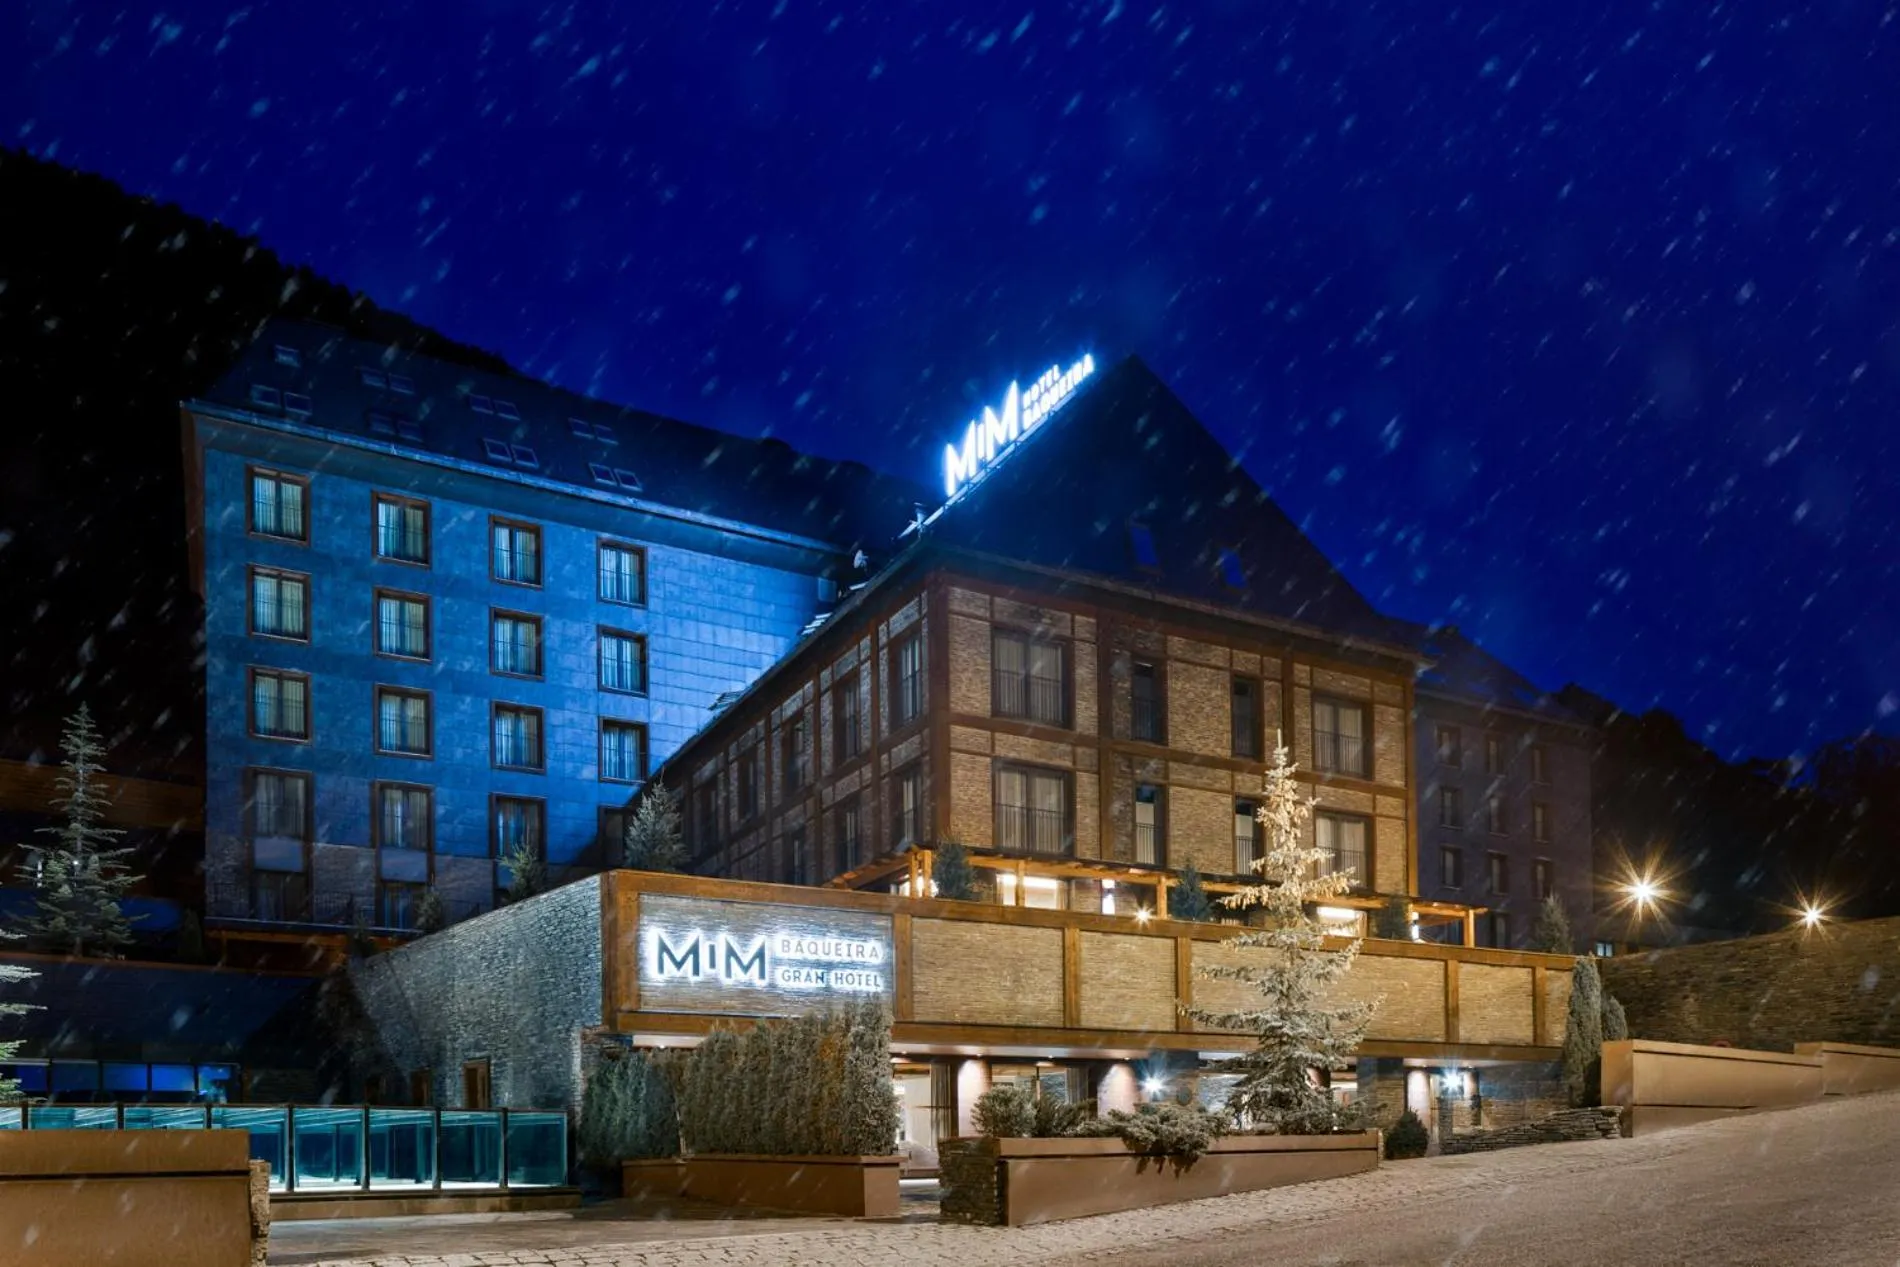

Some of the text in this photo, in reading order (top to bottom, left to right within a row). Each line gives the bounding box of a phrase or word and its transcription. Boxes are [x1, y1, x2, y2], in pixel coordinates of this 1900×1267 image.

[945, 380, 1019, 497] MIM
[657, 935, 766, 980] MIM
[781, 939, 880, 959] BAQUEIRA
[781, 969, 881, 988] GRAN HOTEL
